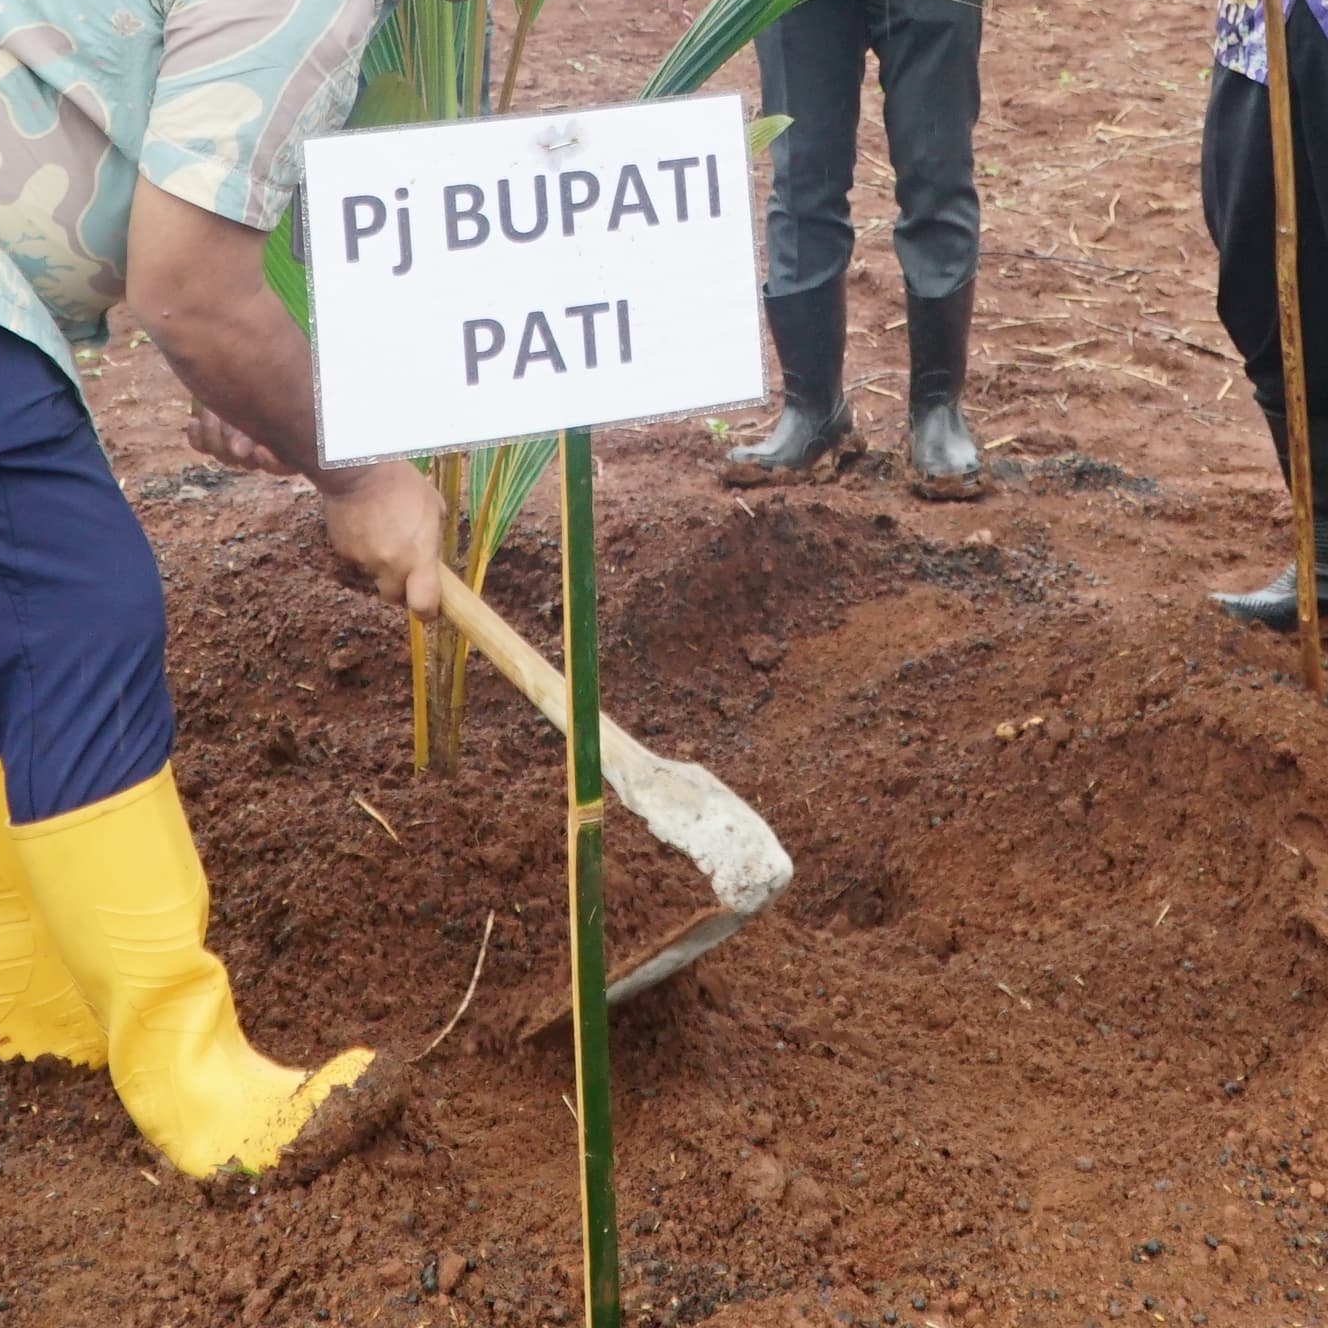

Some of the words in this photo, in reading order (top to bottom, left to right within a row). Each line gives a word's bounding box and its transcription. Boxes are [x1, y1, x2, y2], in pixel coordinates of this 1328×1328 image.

[342, 187, 413, 276] Pj
[443, 154, 721, 251] BUPATI
[462, 299, 633, 386] PATI
